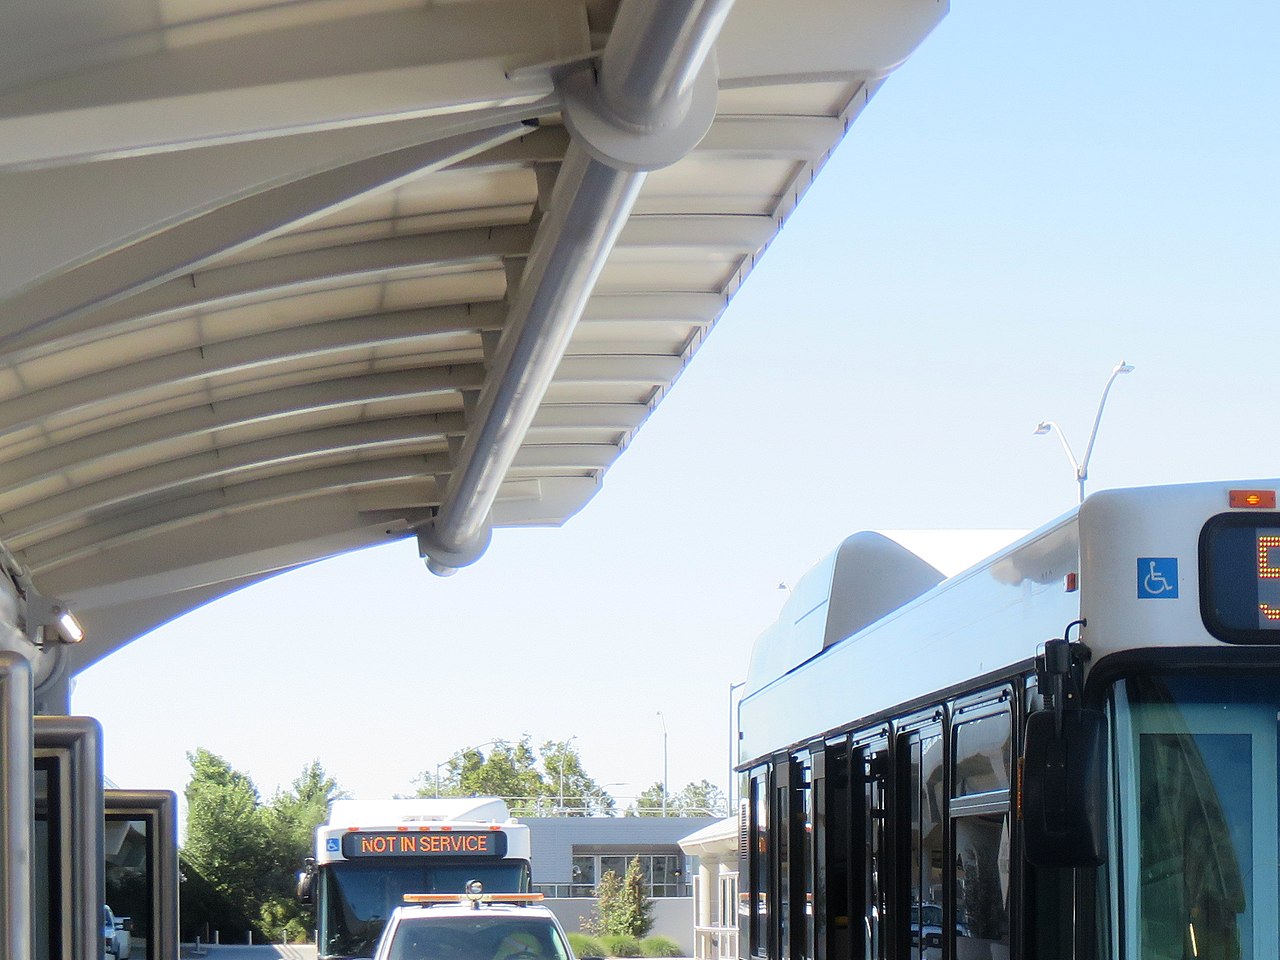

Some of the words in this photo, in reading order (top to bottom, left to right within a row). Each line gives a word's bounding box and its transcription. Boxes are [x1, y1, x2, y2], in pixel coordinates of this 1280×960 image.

[362, 836, 396, 852] NOT
[401, 836, 416, 852] IN
[420, 836, 488, 852] SERVICE
